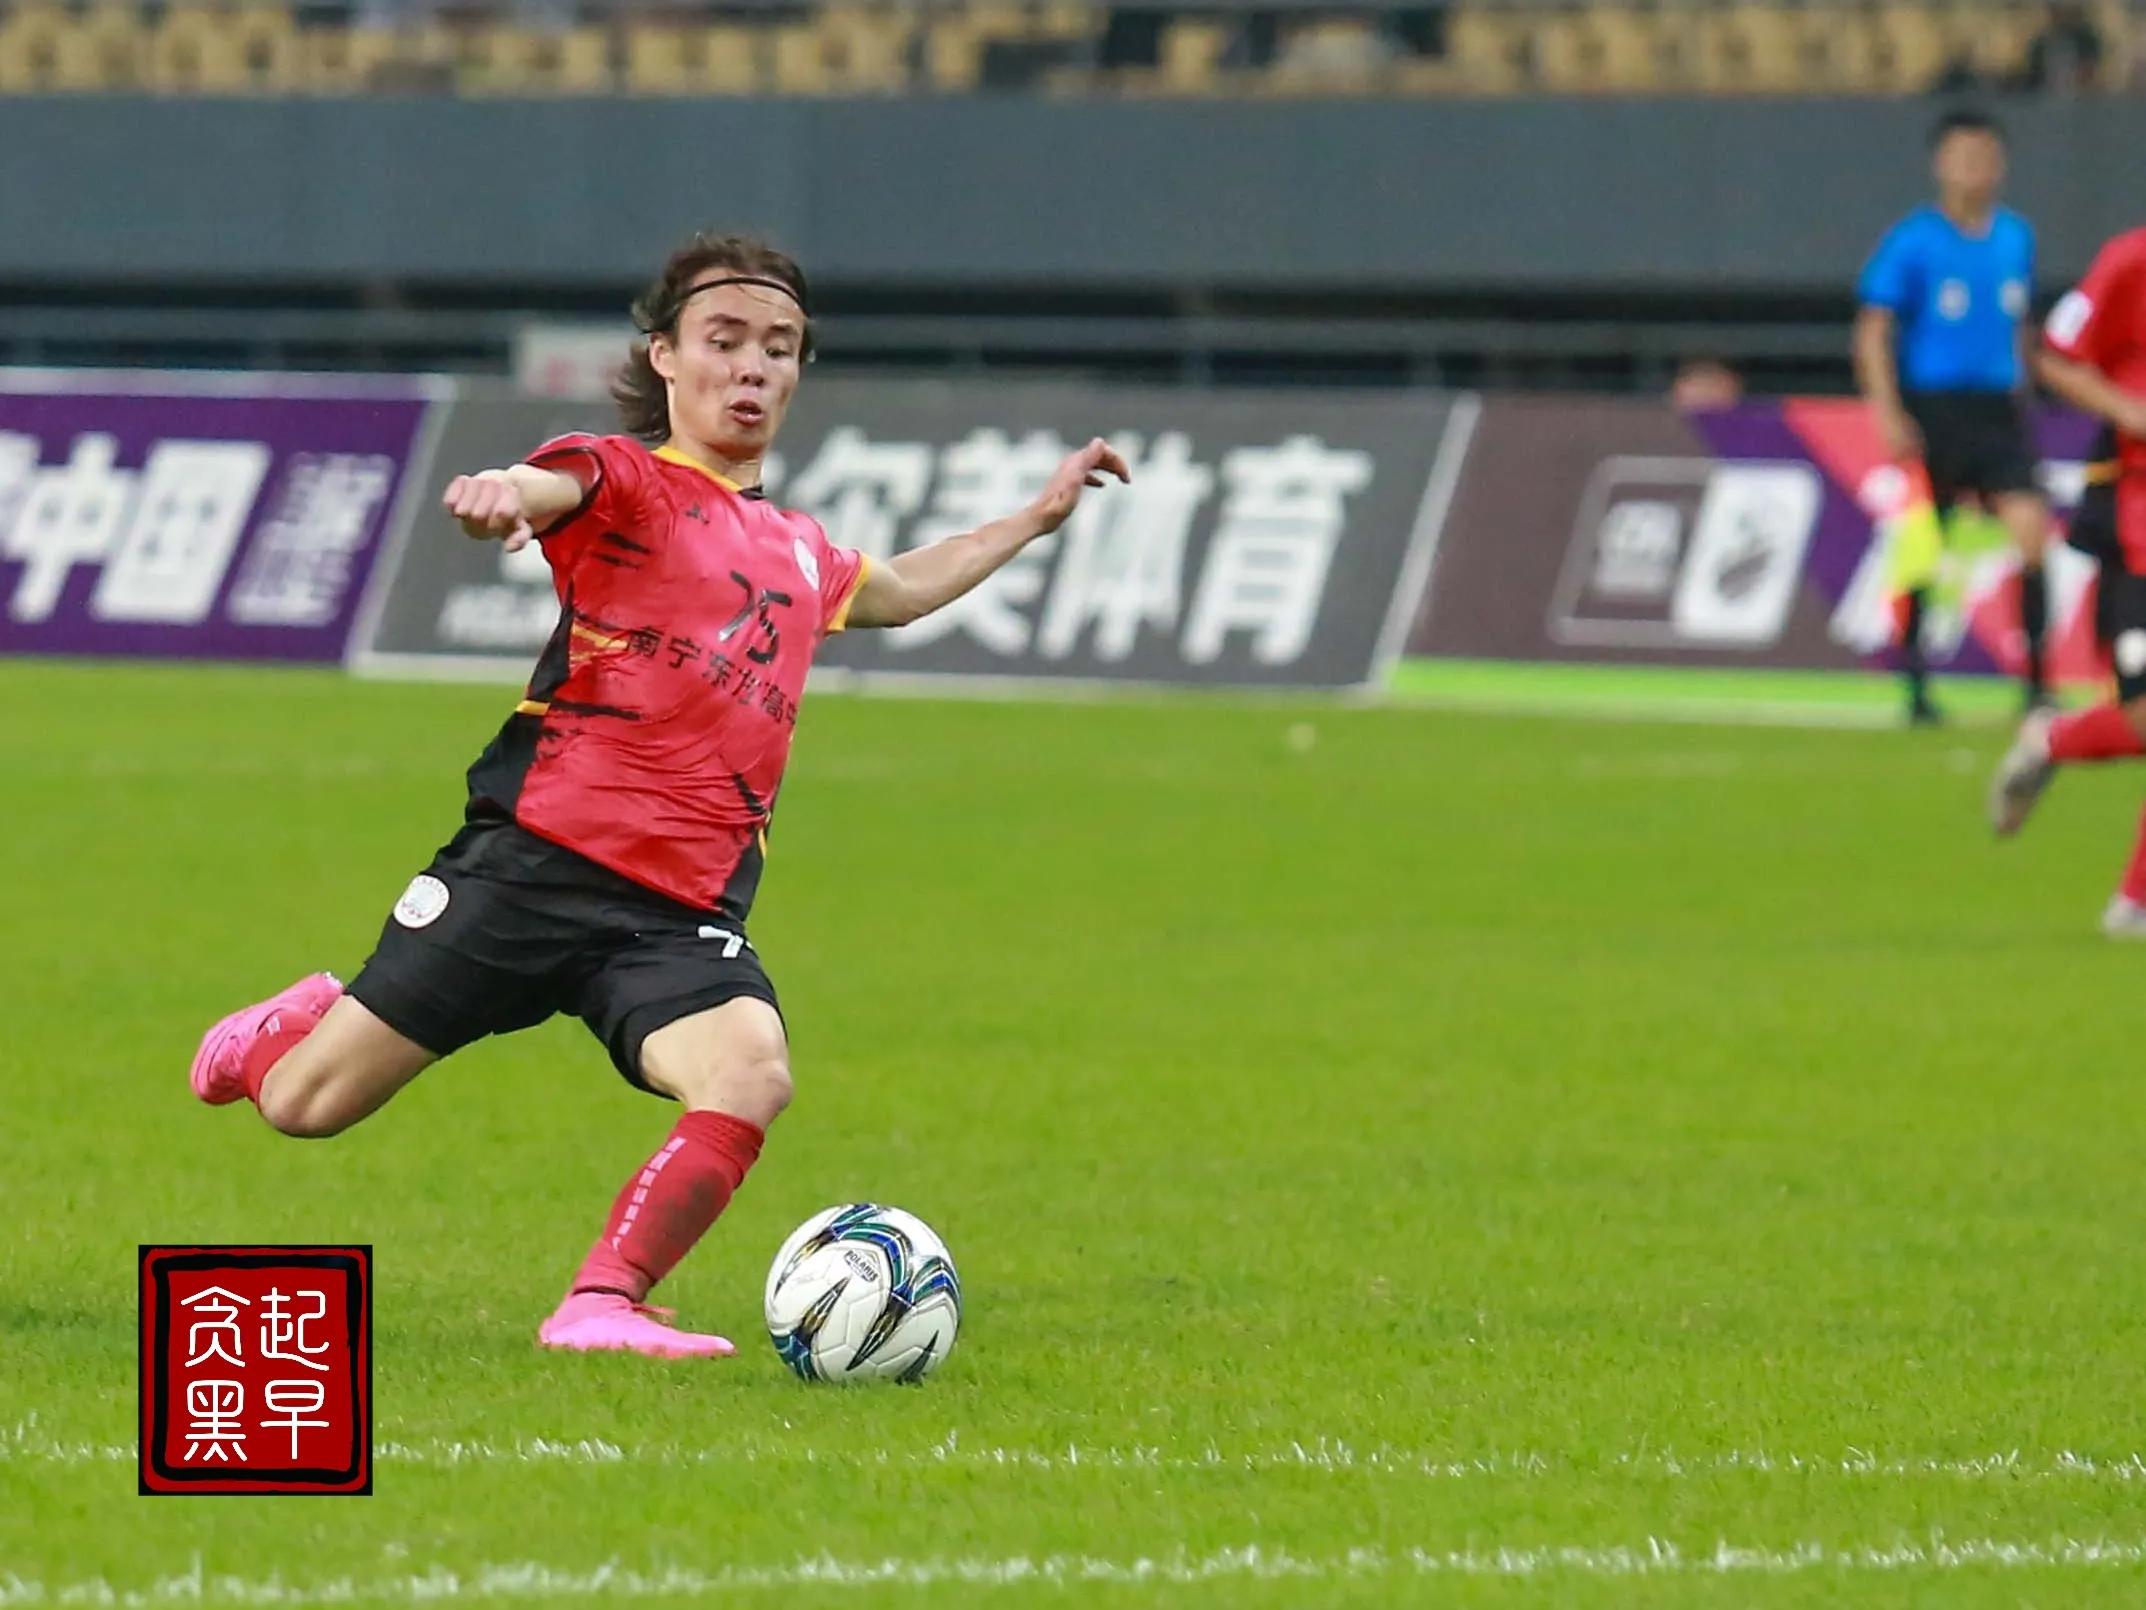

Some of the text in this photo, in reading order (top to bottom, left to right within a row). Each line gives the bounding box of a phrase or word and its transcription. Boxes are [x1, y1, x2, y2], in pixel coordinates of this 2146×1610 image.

[760, 425, 1374, 666] 尔美体育
[717, 569, 793, 665] 75
[697, 924, 754, 959] 7
